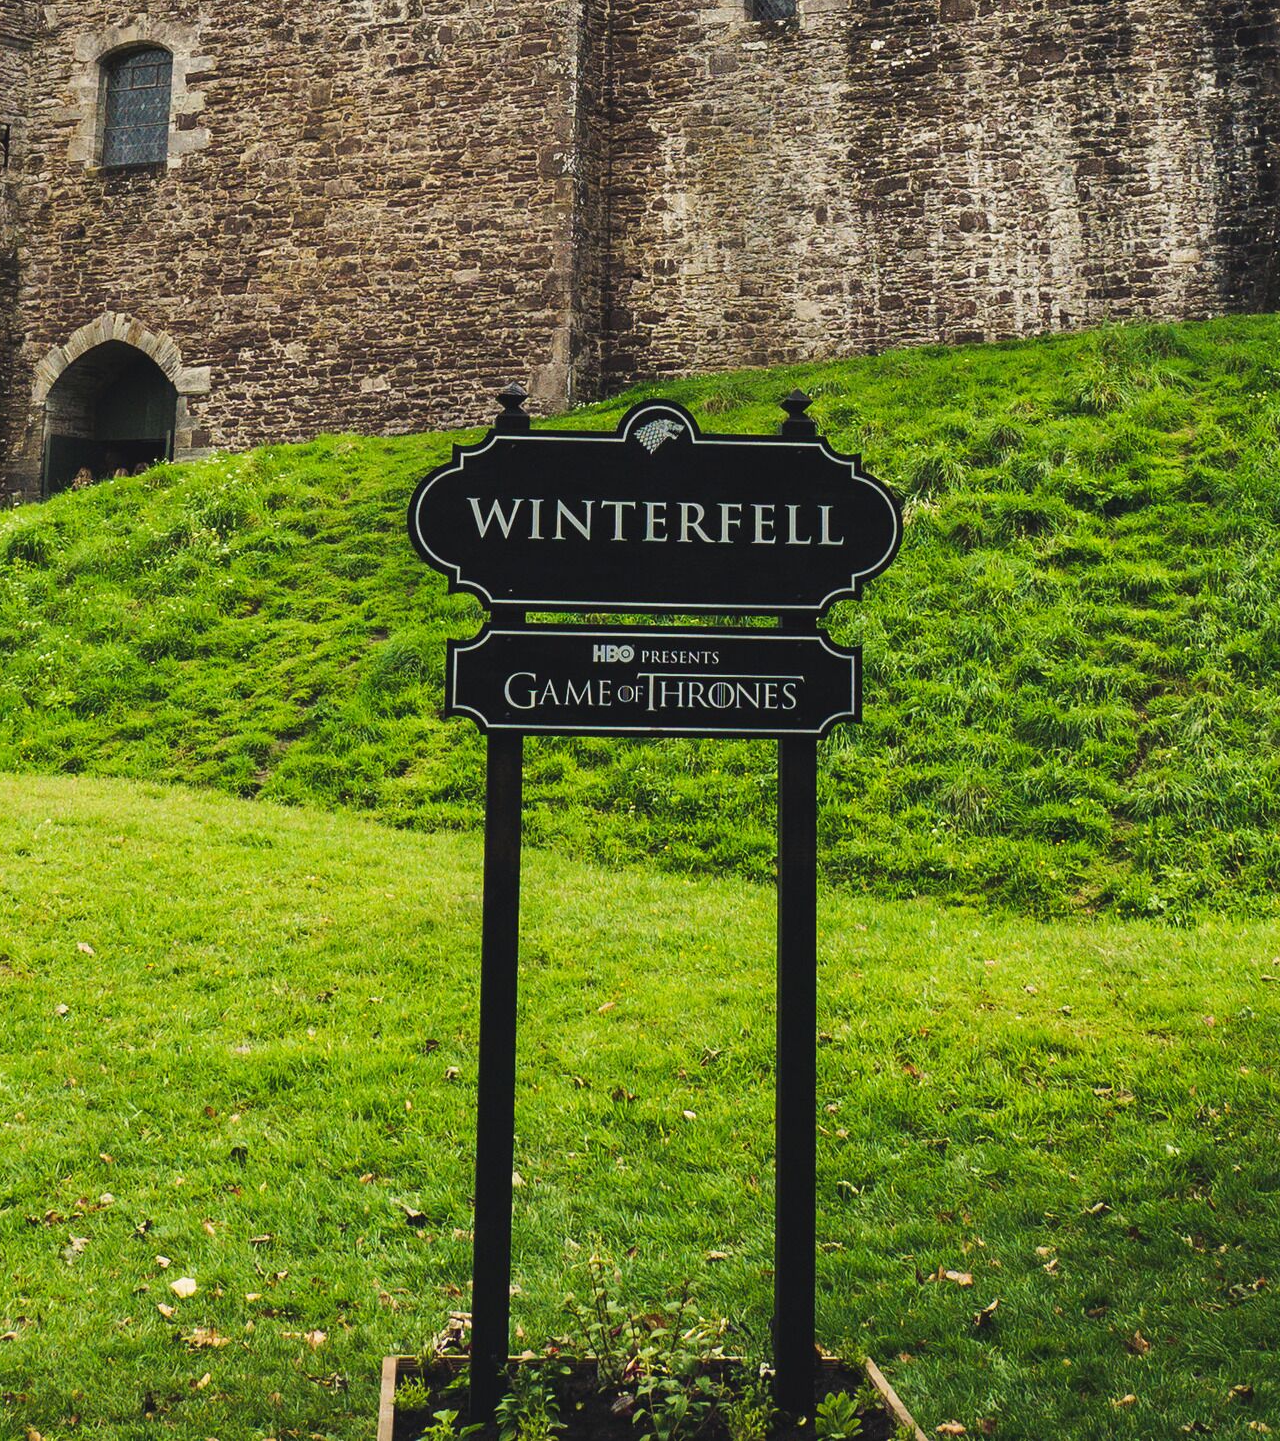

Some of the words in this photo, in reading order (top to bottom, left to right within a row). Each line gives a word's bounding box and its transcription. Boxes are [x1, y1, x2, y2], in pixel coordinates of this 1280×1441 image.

[466, 497, 845, 546] WINTERFELL
[592, 644, 635, 663] HBO
[641, 650, 720, 665] PRESENTS
[504, 671, 612, 710] GAME
[617, 685, 644, 703] OF
[637, 672, 805, 712] THRONES
